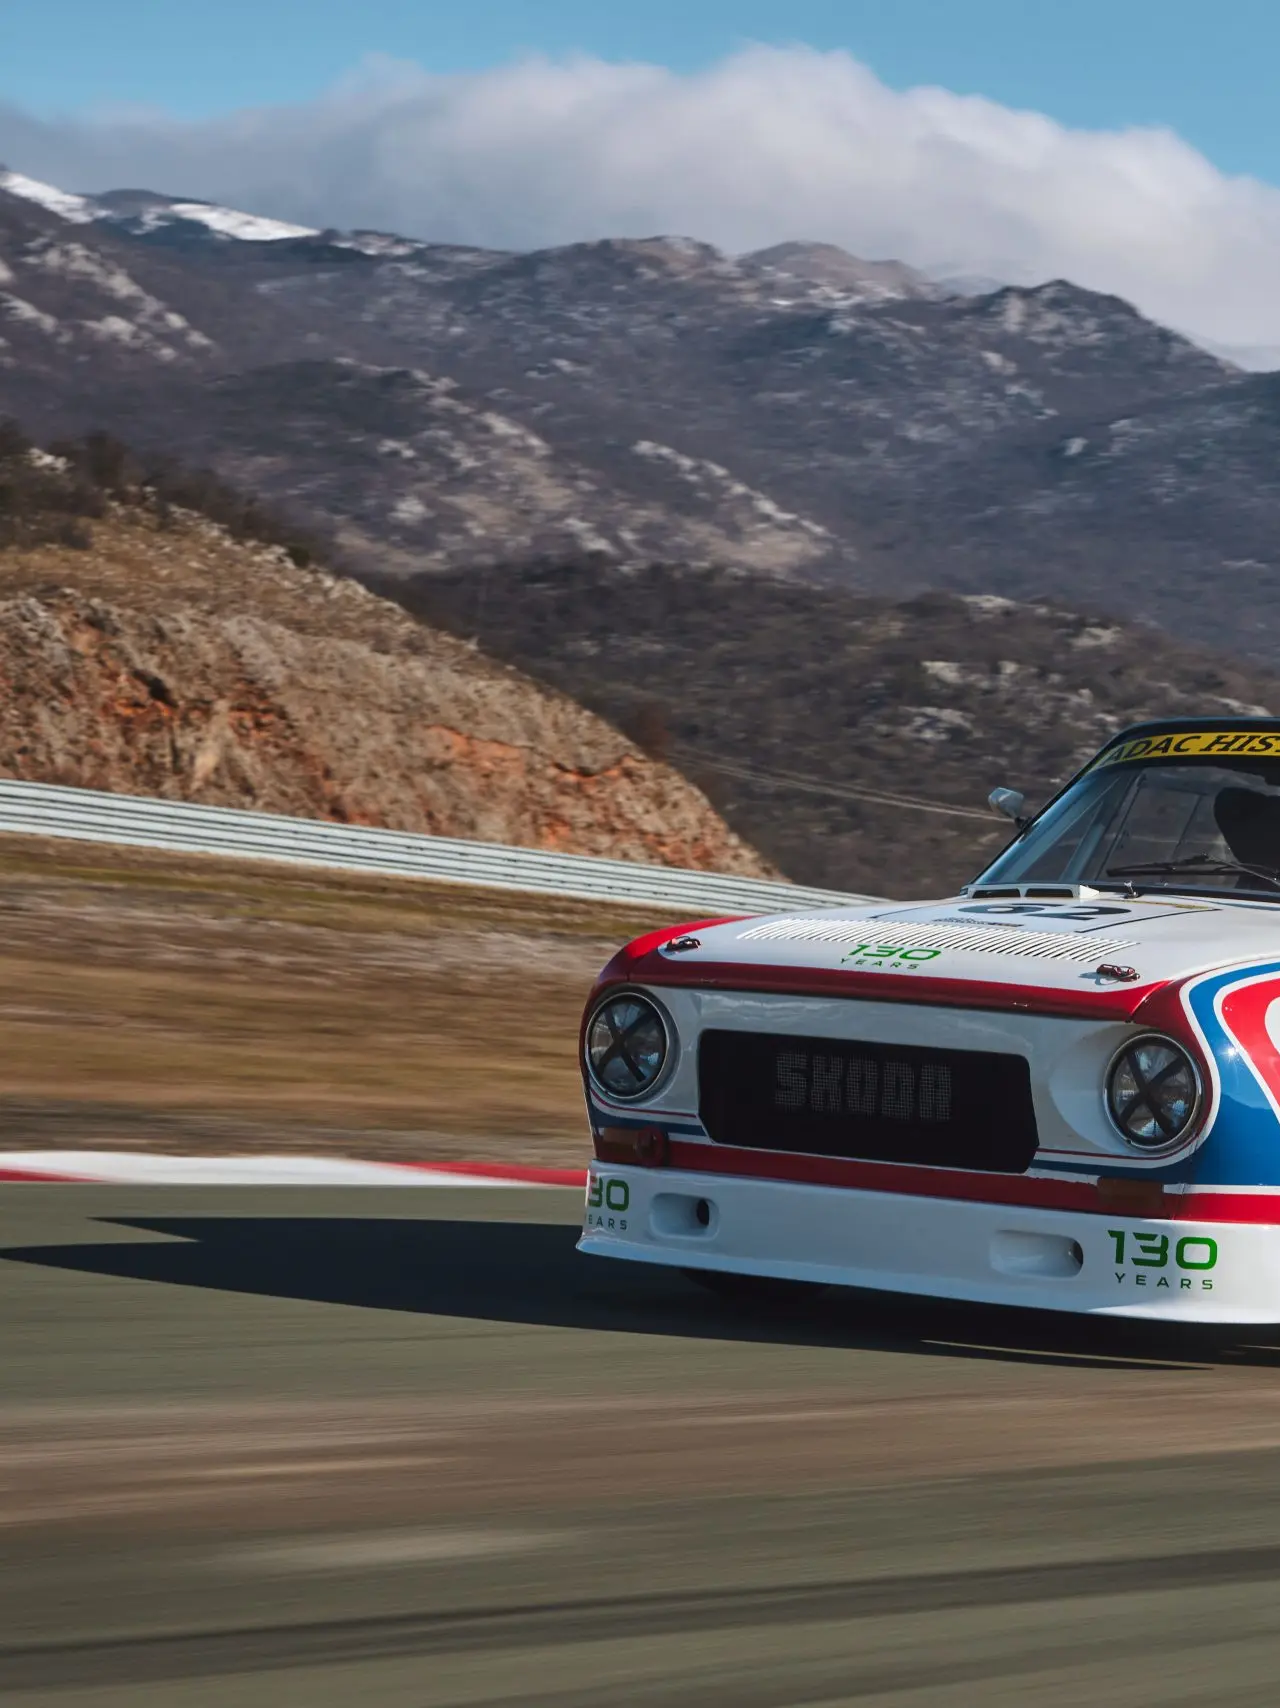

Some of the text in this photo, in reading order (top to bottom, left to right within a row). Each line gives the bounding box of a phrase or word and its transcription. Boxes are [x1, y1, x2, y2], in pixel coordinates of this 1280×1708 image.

[1106, 735, 1202, 762] ADAC
[958, 903, 1132, 921] 62
[847, 944, 942, 962] 130
[840, 957, 920, 970] YEARS
[588, 1175, 630, 1212] 30
[588, 1214, 628, 1230] EARS
[1107, 1229, 1218, 1270] 130
[1114, 1271, 1214, 1290] YEARS
